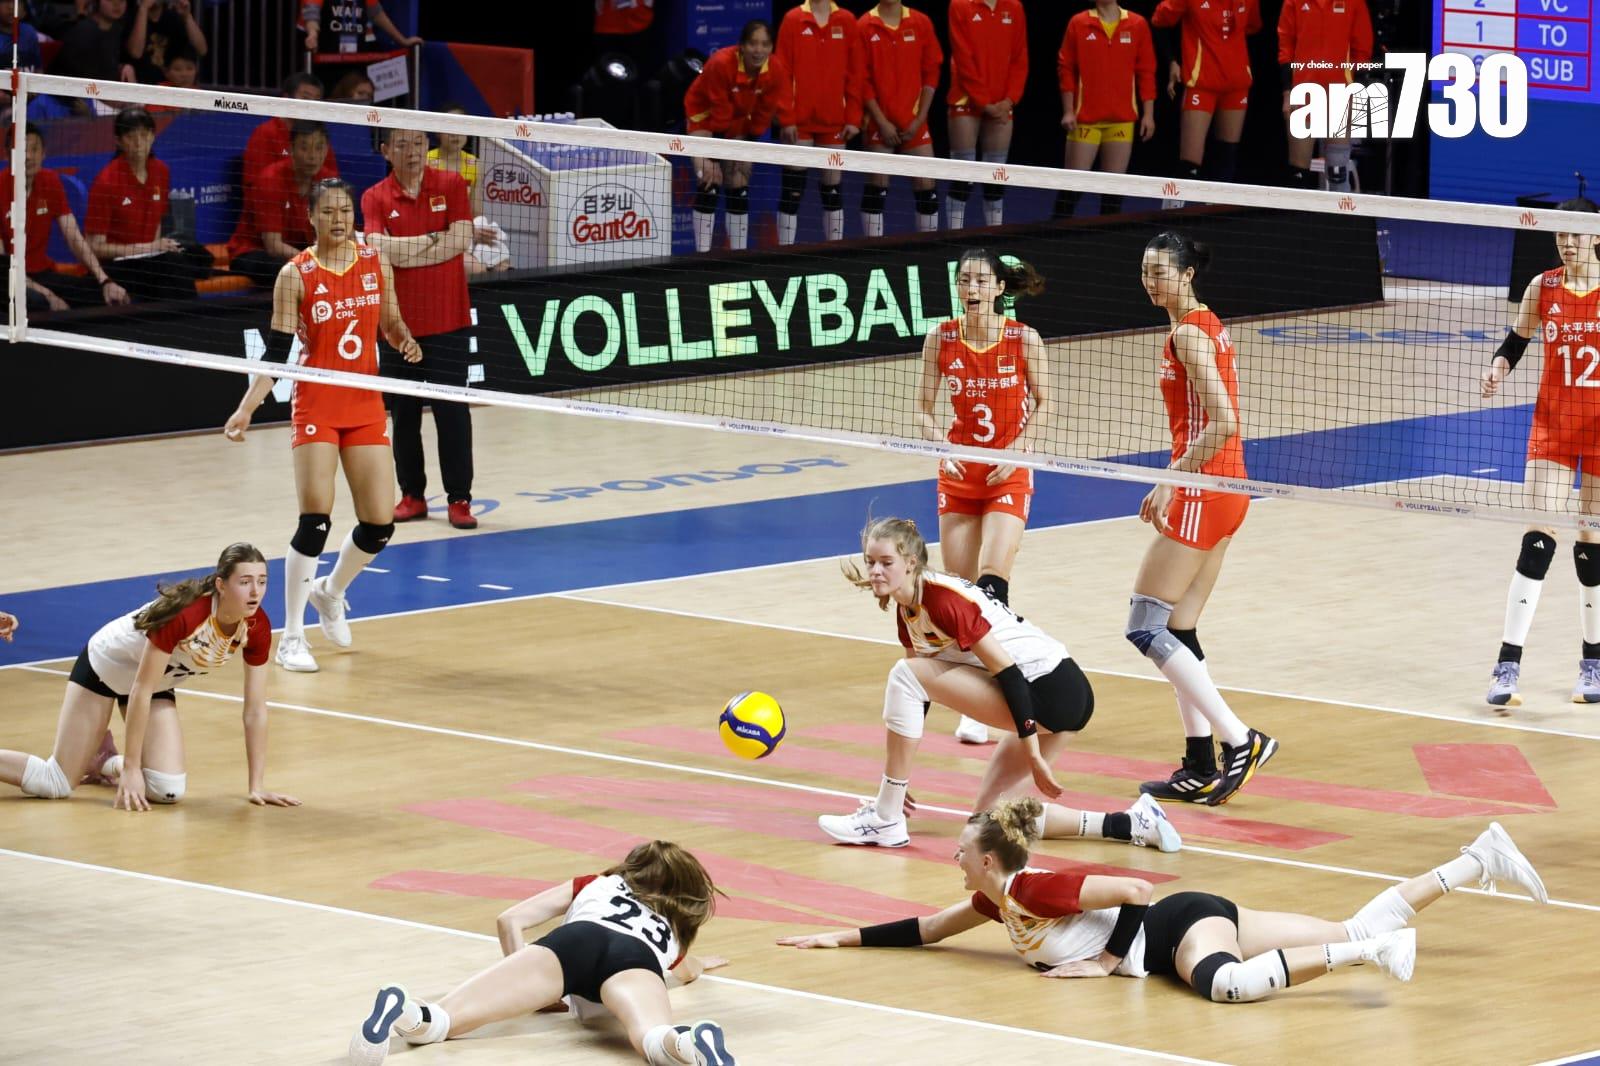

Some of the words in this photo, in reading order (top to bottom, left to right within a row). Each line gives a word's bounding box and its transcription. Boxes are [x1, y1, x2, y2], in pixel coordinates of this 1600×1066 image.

[1474, 20, 1484, 43] 1
[1538, 24, 1568, 47] TO
[1530, 57, 1574, 82] SUB
[1191, 94, 1200, 106] 5
[493, 169, 529, 185] 百岁山
[584, 192, 633, 214] 百岁山
[336, 310, 357, 319] CPIC
[337, 319, 362, 360] 6
[1562, 334, 1584, 342] CPIC
[1557, 344, 1600, 387] 12
[965, 390, 988, 398] CPIC
[972, 403, 996, 443] 3
[601, 895, 672, 954] 23
